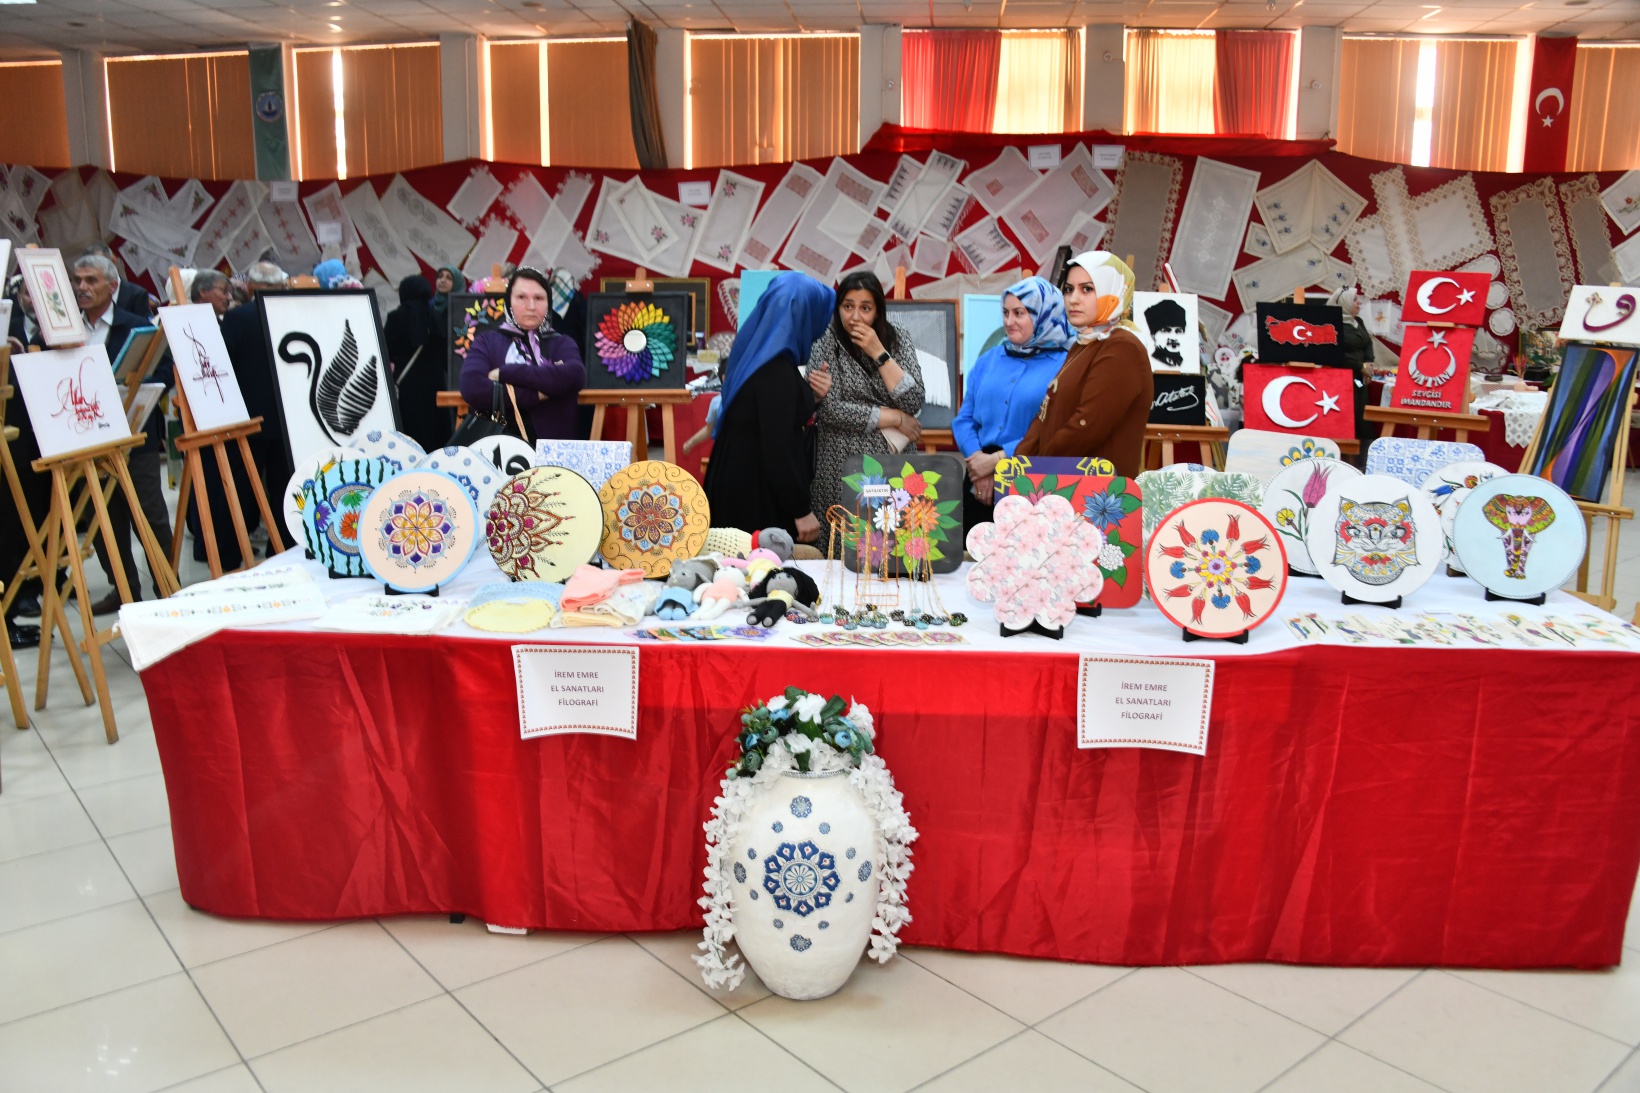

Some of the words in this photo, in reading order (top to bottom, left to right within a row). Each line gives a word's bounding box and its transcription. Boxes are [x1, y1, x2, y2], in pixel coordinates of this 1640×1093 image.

[1411, 369, 1451, 387] VATAN
[554, 669, 575, 679] İREM
[576, 671, 599, 679] EMRE
[550, 684, 559, 692] EL
[561, 685, 605, 693] SANATLARI
[1121, 681, 1143, 691] İREM
[1144, 683, 1168, 692] EMRE
[558, 698, 598, 706] FİLOGRAFİ
[1115, 697, 1124, 705] EL
[1126, 697, 1171, 706] SANATLARI
[1121, 710, 1162, 720] FİLOGRAFİ
